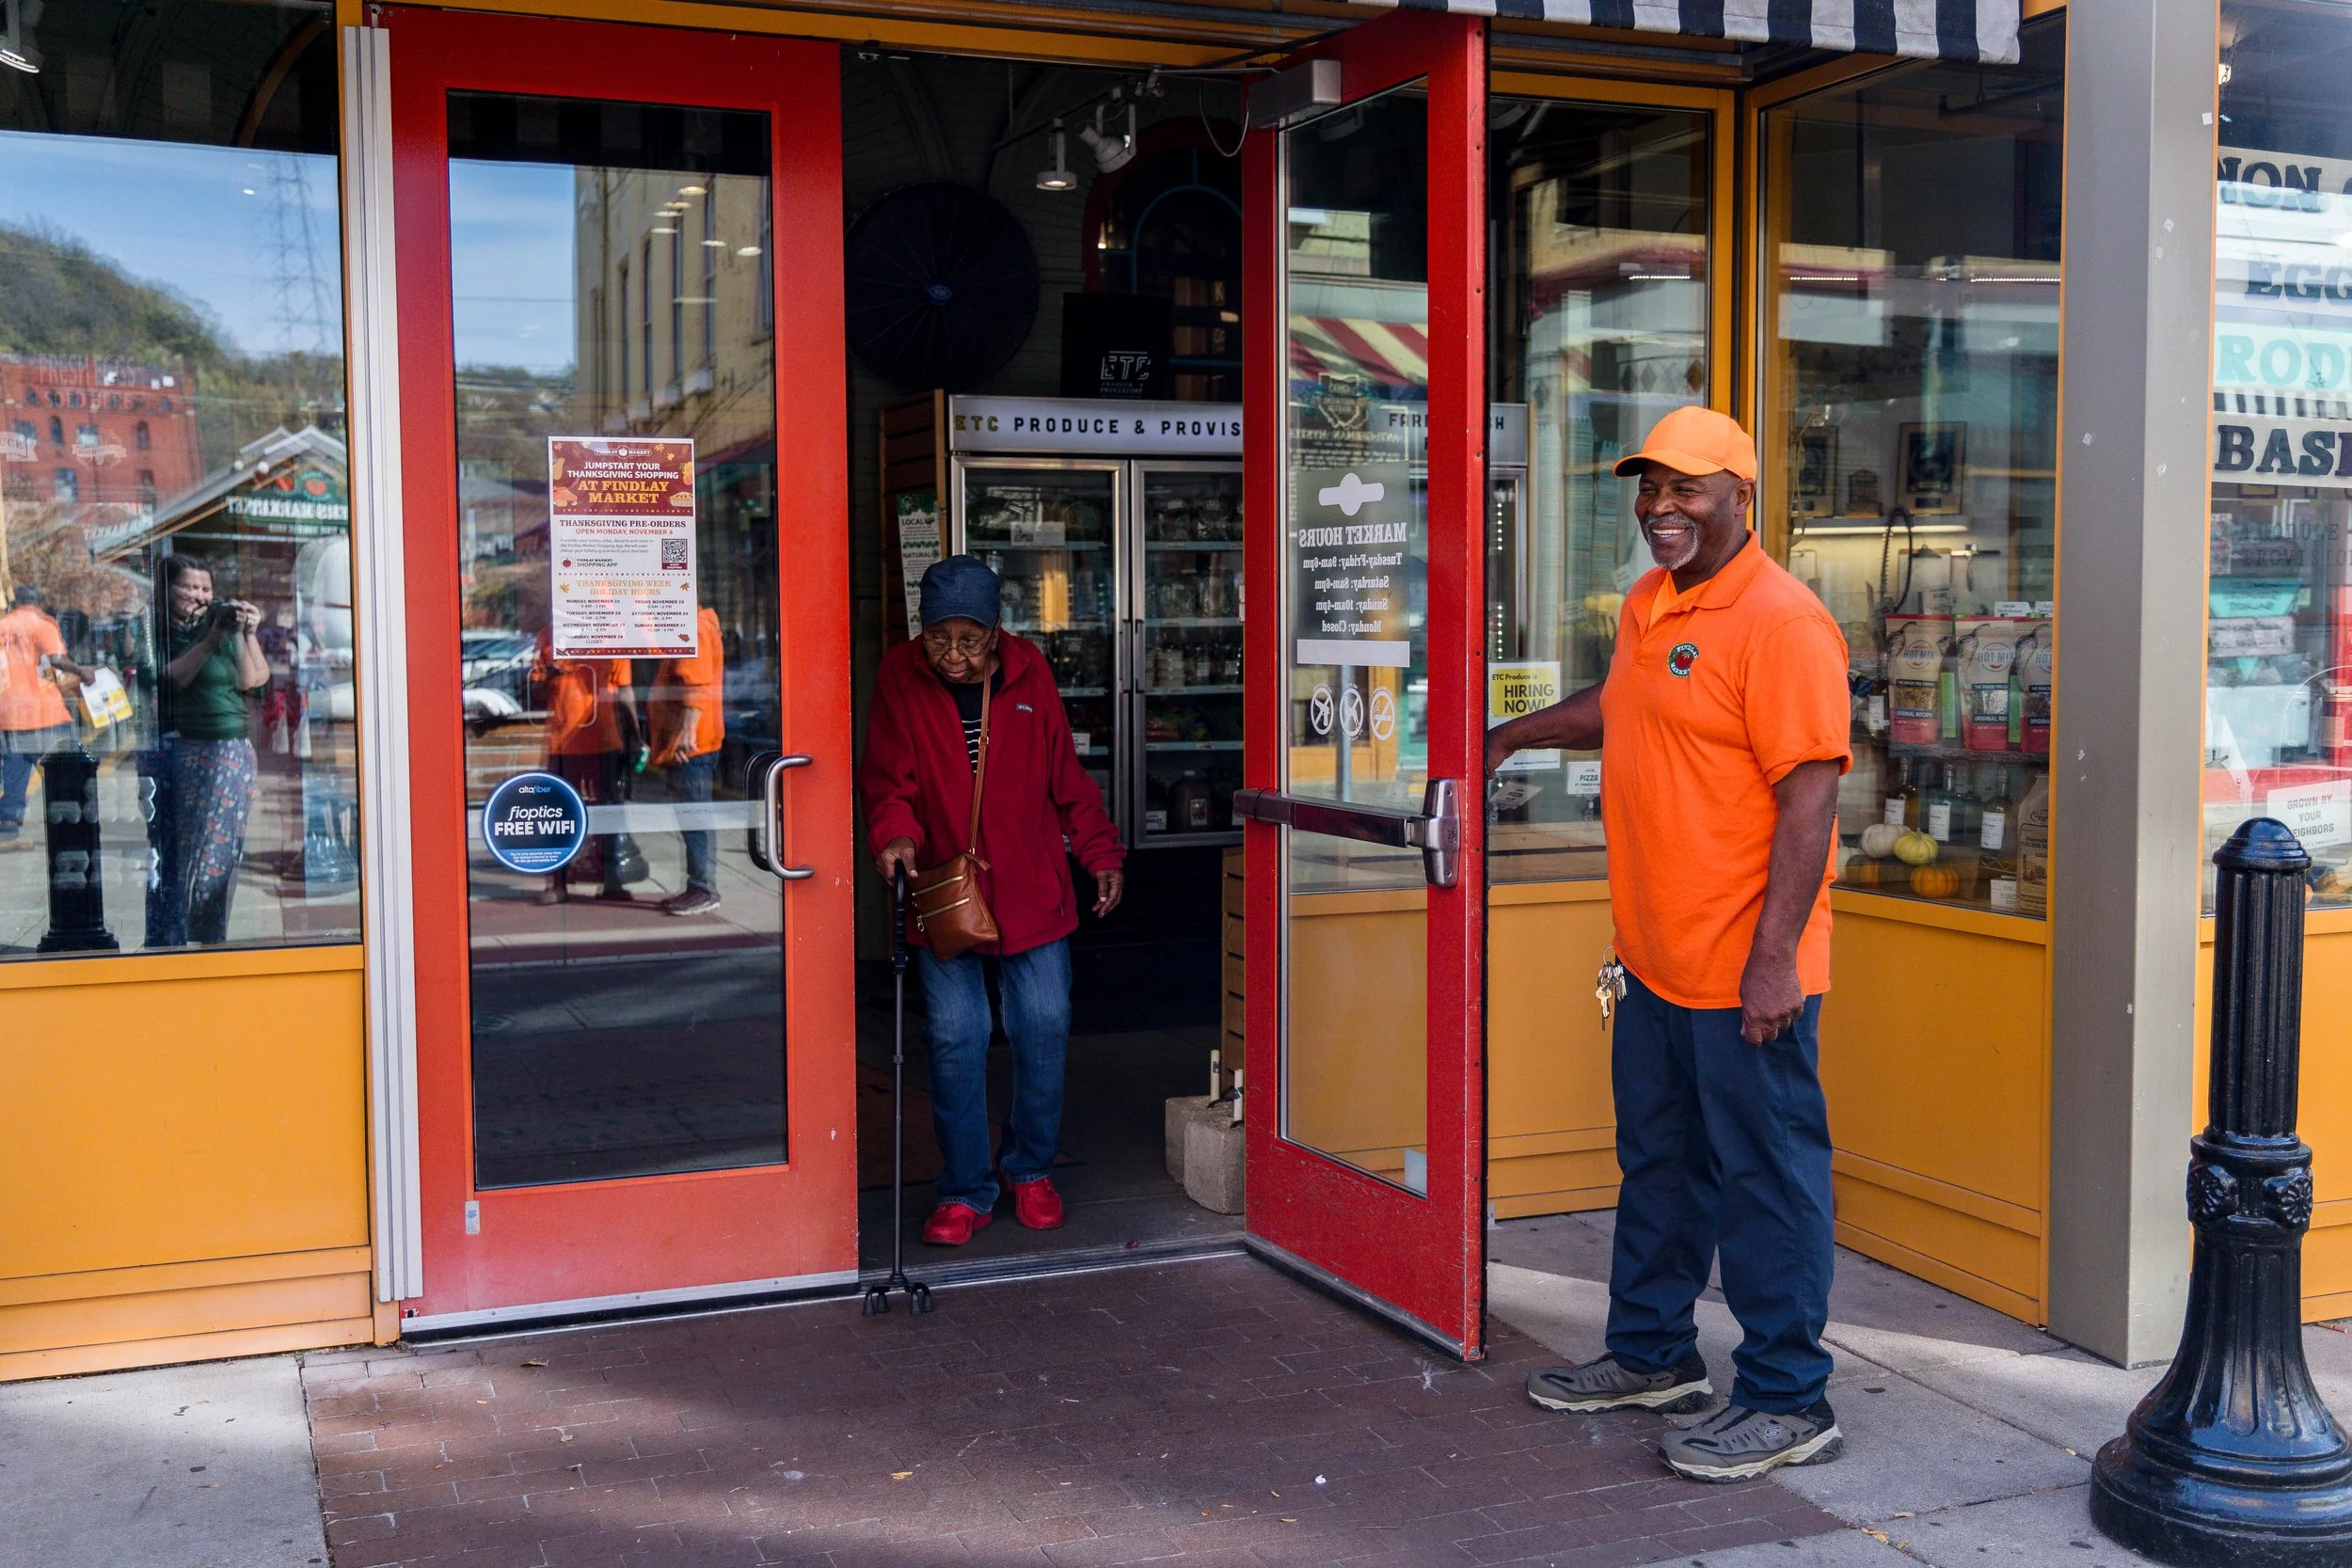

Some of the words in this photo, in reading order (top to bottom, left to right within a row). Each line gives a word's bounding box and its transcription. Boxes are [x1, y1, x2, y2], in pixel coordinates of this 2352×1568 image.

[1101, 356, 1152, 380] ETC
[2217, 335, 2352, 389] ROD
[955, 416, 998, 432] ETC
[1014, 418, 1119, 434] PRODUCE
[1135, 420, 1145, 435] &
[1161, 420, 1240, 436] PROVIS
[584, 462, 635, 470] JUMPSTART
[578, 481, 598, 491] AT
[602, 481, 669, 492] FINDLAY
[589, 492, 659, 504] MARKET
[1904, 649, 1920, 659] HOT
[1920, 649, 1934, 660] MIX
[1978, 651, 1995, 663] HOT
[1504, 684, 1554, 698] HIRING
[1504, 699, 1546, 713] NOW!
[2287, 796, 2319, 810] GROWN
[2321, 794, 2333, 804] BY
[508, 805, 563, 821] fioptics
[2298, 811, 2321, 823] YOUR
[494, 822, 534, 836] FREE
[537, 820, 575, 835] WIFI
[2293, 823, 2334, 838] EIGHBORS
